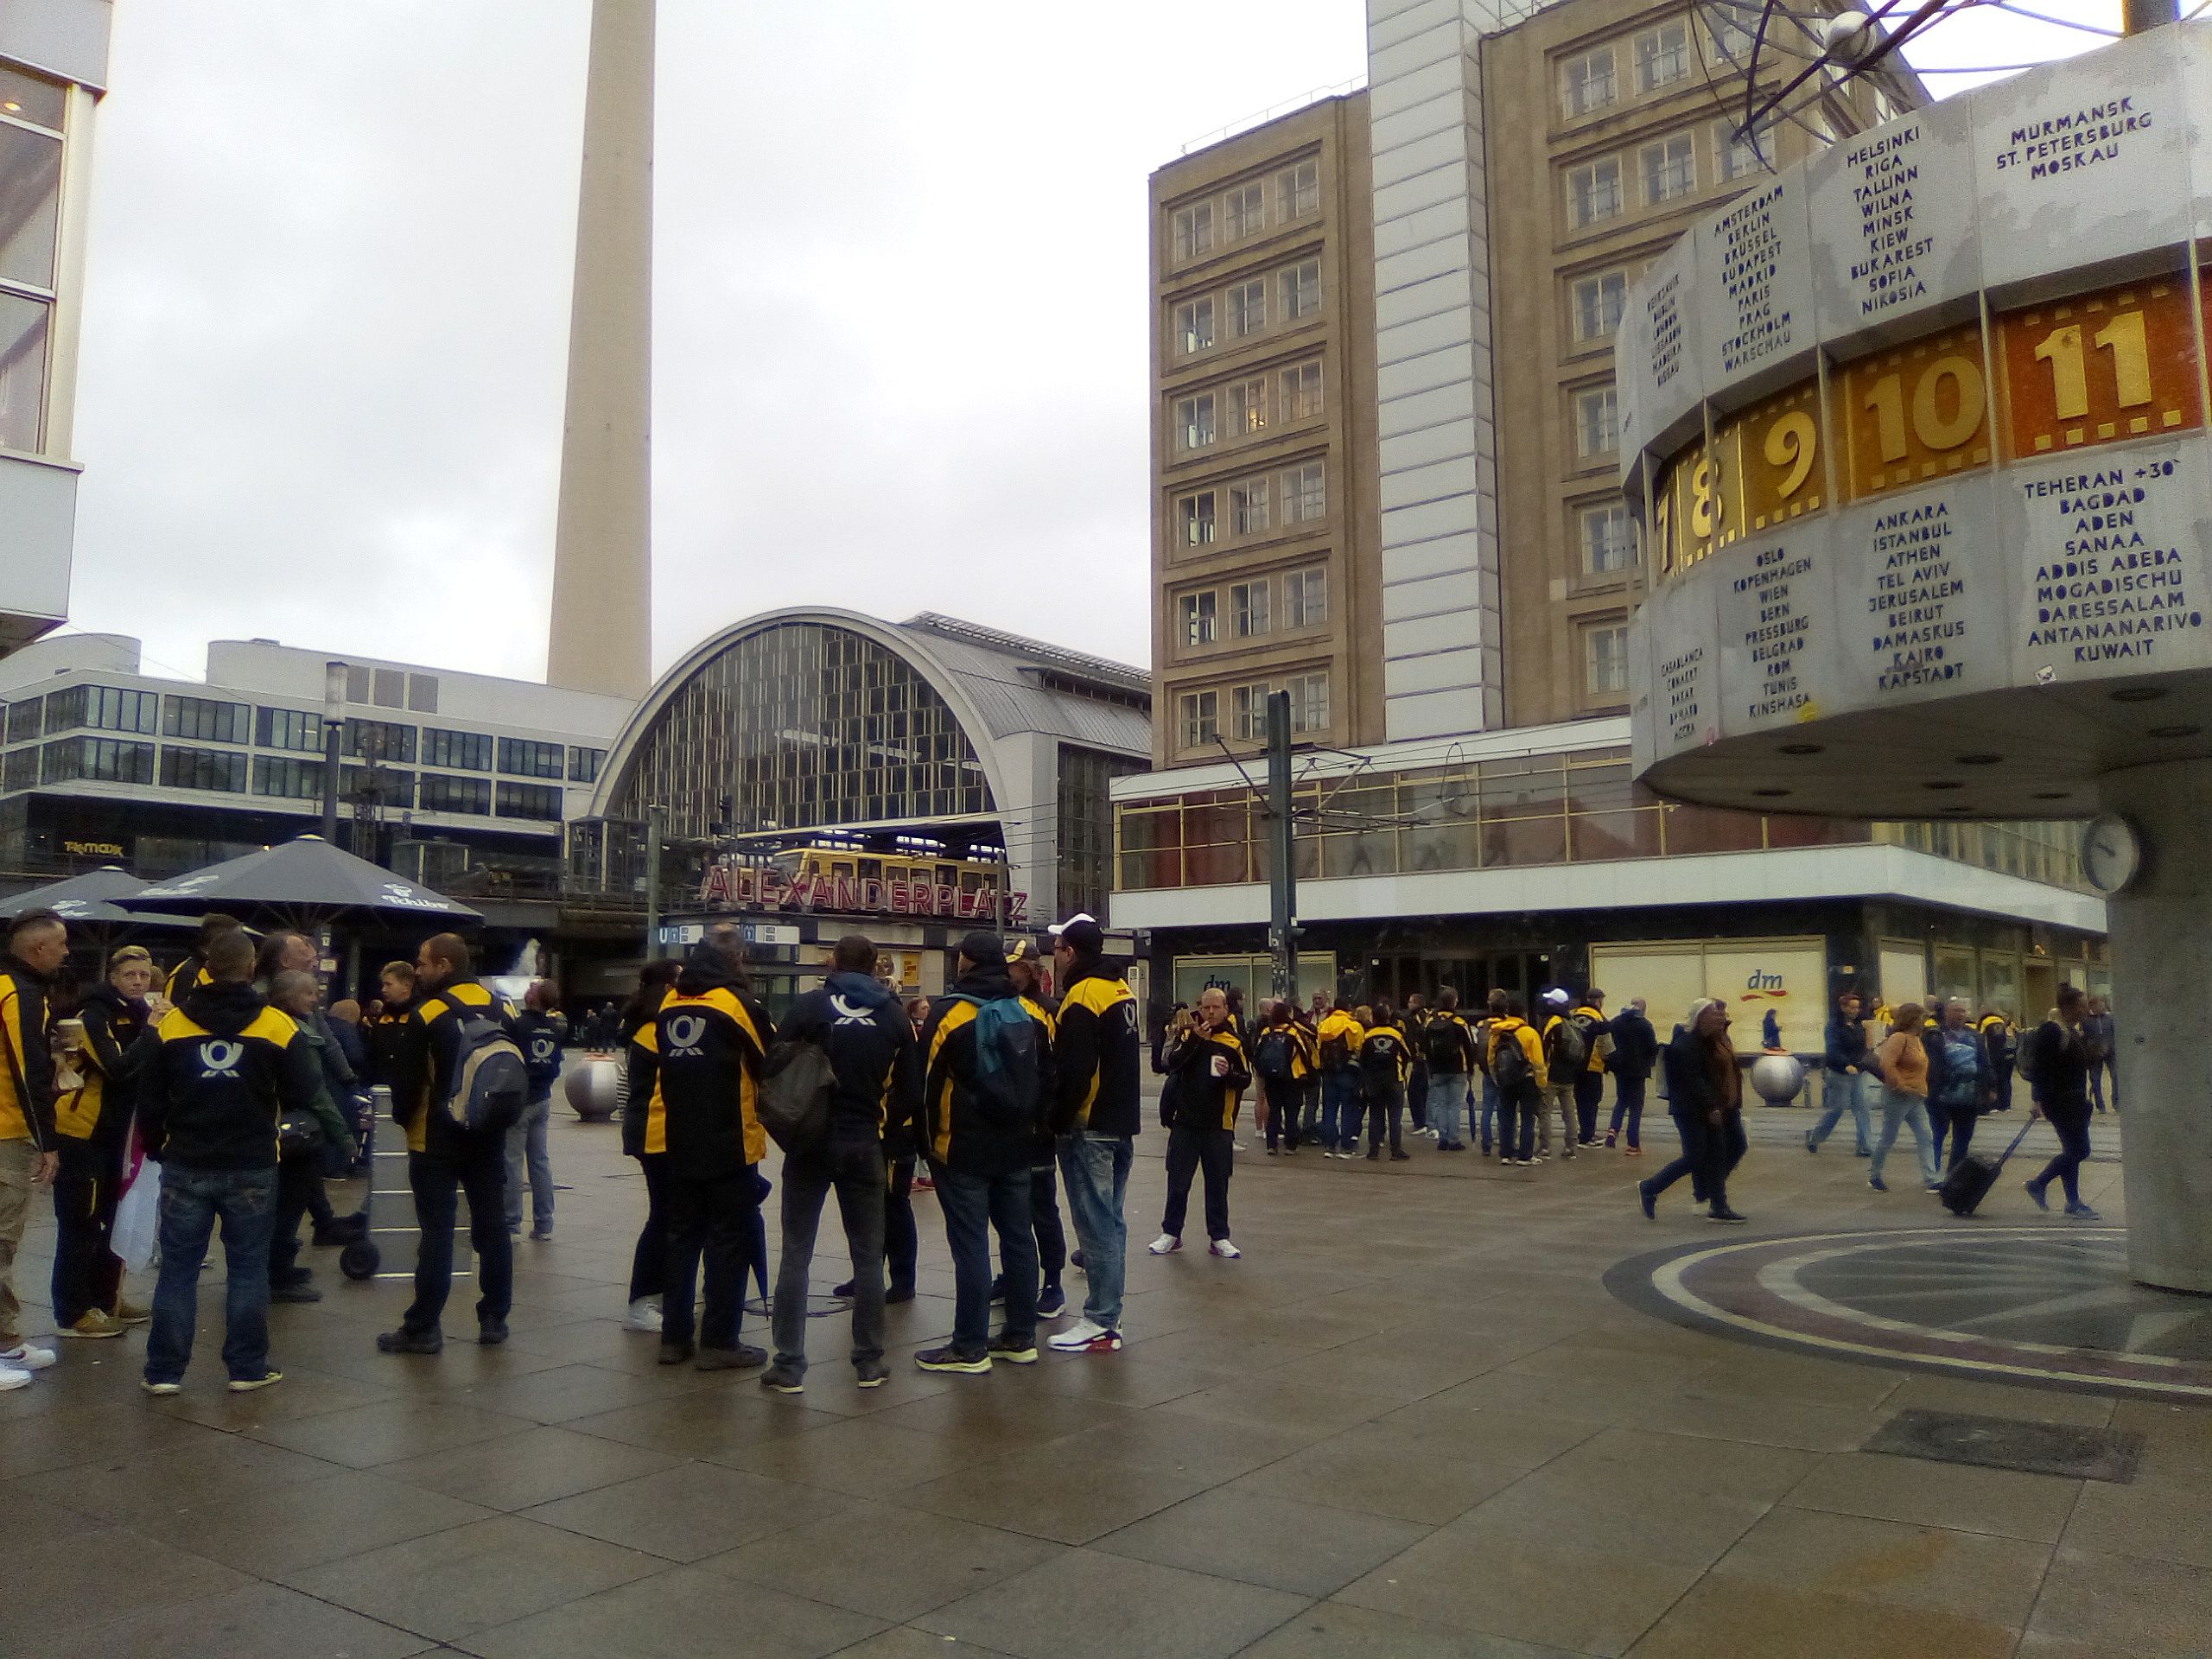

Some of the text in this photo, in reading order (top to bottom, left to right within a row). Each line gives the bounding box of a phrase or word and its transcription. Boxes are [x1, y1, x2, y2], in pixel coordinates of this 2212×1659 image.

[2011, 96, 2132, 145] MURMANSK
[1847, 125, 1920, 168] HELSINKI
[1997, 111, 2152, 169] ST. PETERSBURG
[1866, 154, 1903, 180] RIGA
[2031, 143, 2118, 180] MOSKAU
[1853, 165, 1918, 202] TALLINN
[1715, 185, 1783, 238] AMSTERDAM
[1861, 188, 1912, 218] WILNA
[1728, 212, 1770, 245] BERLIN
[1863, 205, 1914, 238] MINSK
[1871, 227, 1908, 254] KIEW
[1722, 241, 1782, 285] BUDAPEST
[1851, 237, 1932, 280] BUKAREST
[1729, 264, 1776, 299] MADRID
[1869, 265, 1915, 293] SOFIA
[1738, 284, 1770, 312] PARIS
[1862, 281, 1926, 315] NIKOSIA
[1739, 303, 1770, 329] PRAG
[1722, 311, 1790, 356] STOCKHOLM
[1724, 329, 1790, 373] WARSCHAU
[2036, 310, 2152, 421] 11
[1866, 356, 1985, 464] 10
[1764, 411, 1817, 499] 9
[1693, 457, 1723, 538] 8
[2024, 469, 2123, 499] TEHERAN
[2060, 487, 2145, 515] BAGDAD
[1874, 502, 1948, 532] ANKARA
[2075, 511, 2133, 534] ADEN
[1873, 522, 1952, 552] ISTANBUL
[2065, 531, 2144, 556] SANAA
[1757, 548, 1784, 567] OSLO
[1886, 543, 1941, 569] ATHEN
[2036, 547, 2182, 582] ADDIS ABEBA
[1733, 557, 1811, 594] KOPENHAGEN
[1878, 562, 1951, 590] TEL AVIV
[2038, 569, 2182, 602] MOGADISCHU
[1758, 584, 1788, 604] WIEN
[1868, 580, 1964, 613] JERUSALEM
[2038, 591, 2184, 624] DARESSALAM
[1760, 603, 1789, 623] BERN
[1889, 604, 1943, 628] BEIRUT
[1745, 615, 1809, 646] PRESSBURG
[1872, 621, 1964, 651] DAMASKUS
[2028, 611, 2202, 647] ANTANANARIVO
[1752, 637, 1804, 662] BELGRAD
[1893, 645, 1943, 668] KAIRO
[2074, 639, 2153, 663] KUWAIT
[1767, 659, 1790, 677] ROM
[1878, 663, 1963, 690] KAPSTADT
[1764, 677, 1797, 696] TUNIS
[1749, 692, 1811, 718] KINSHASA
[1748, 969, 1783, 989] dm
